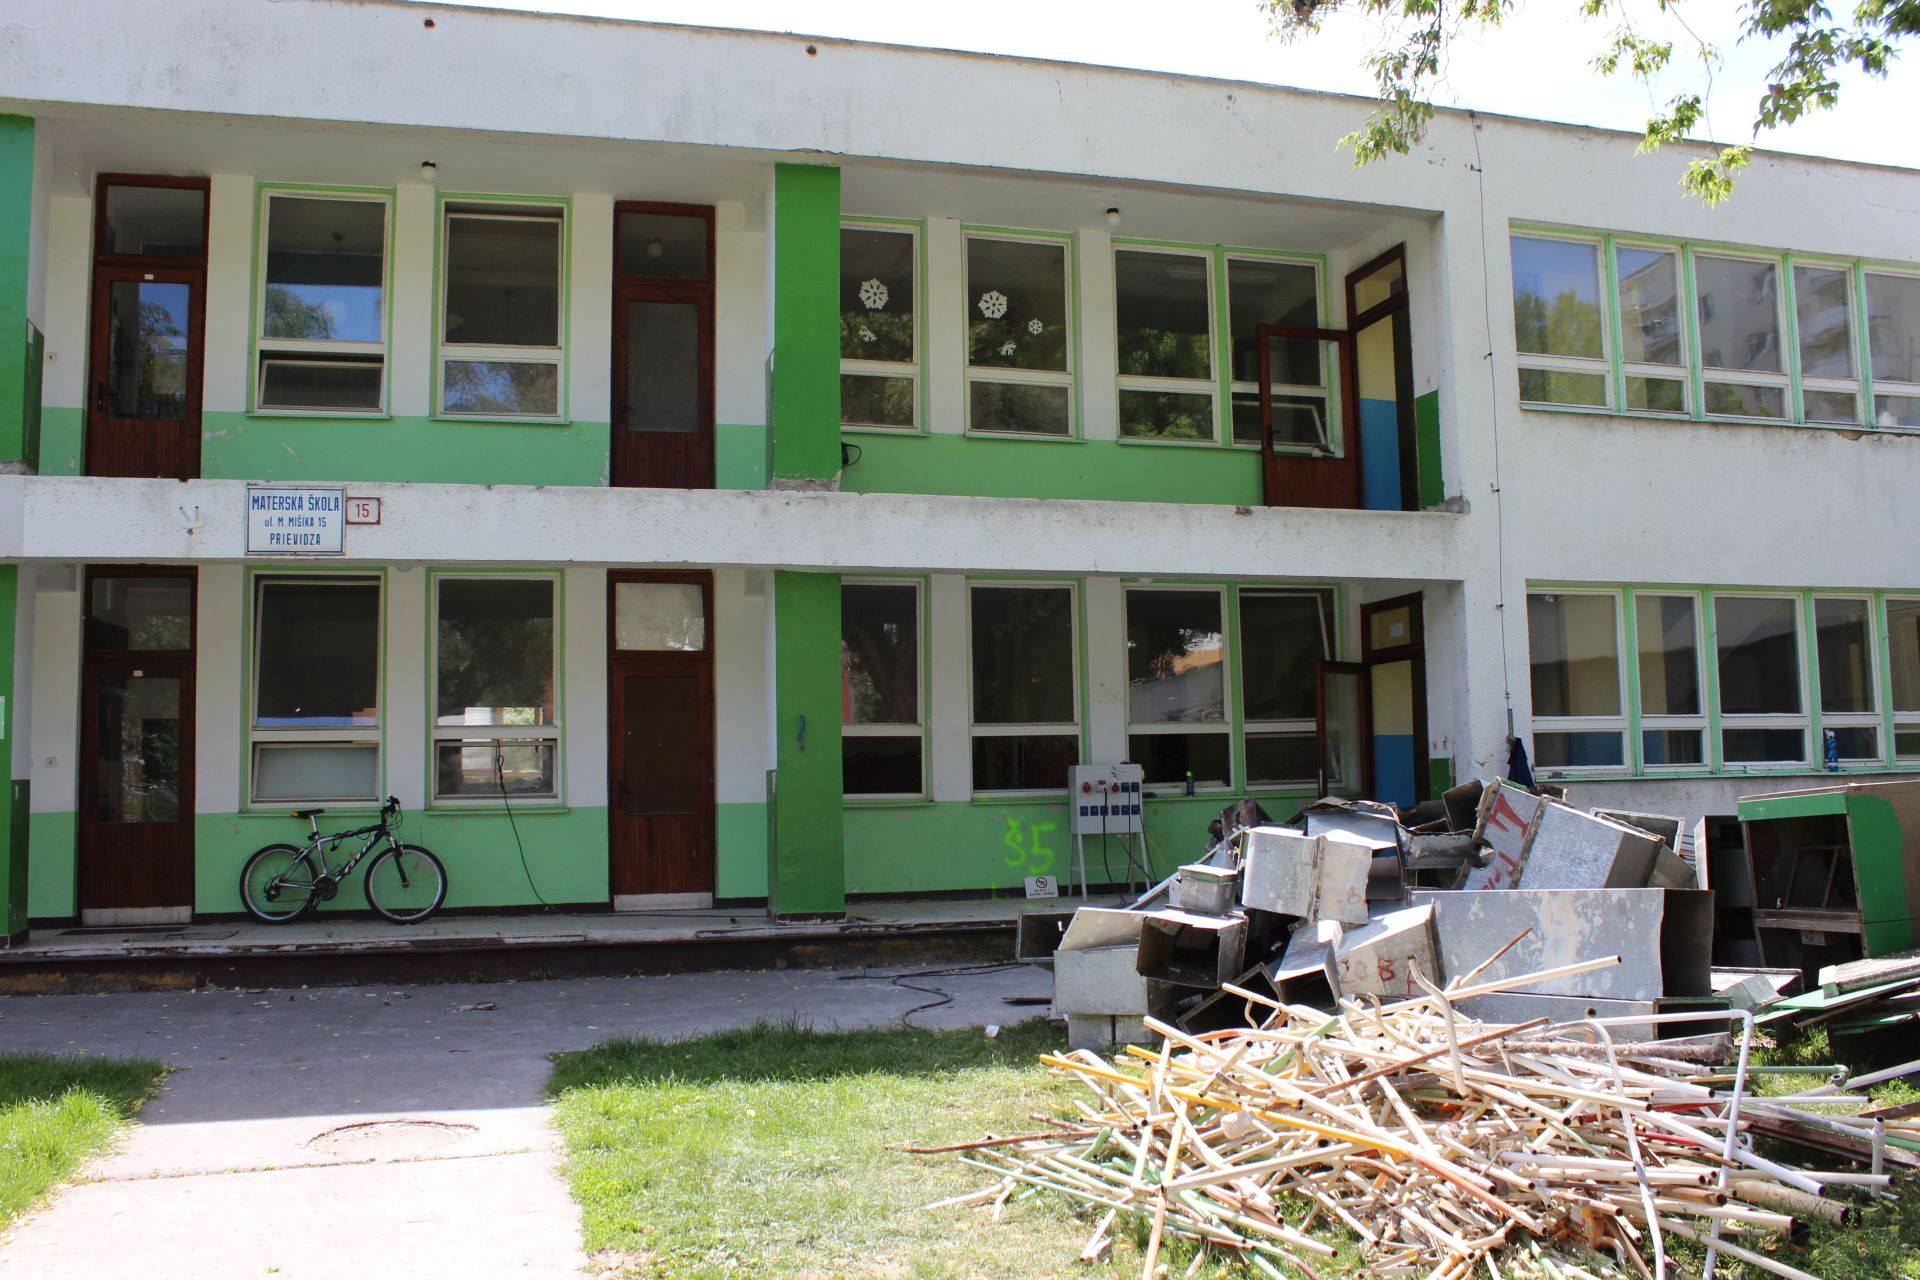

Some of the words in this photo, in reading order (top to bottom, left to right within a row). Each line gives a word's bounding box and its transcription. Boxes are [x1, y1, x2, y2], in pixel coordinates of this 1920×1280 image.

[251, 493, 304, 511] MATERSKÁ
[308, 493, 340, 512] ŠKOLA
[355, 502, 370, 518] 15
[264, 516, 275, 528] ul.
[277, 516, 287, 528] M.
[318, 516, 327, 528] 15
[269, 532, 321, 546] PRIEVIDZA
